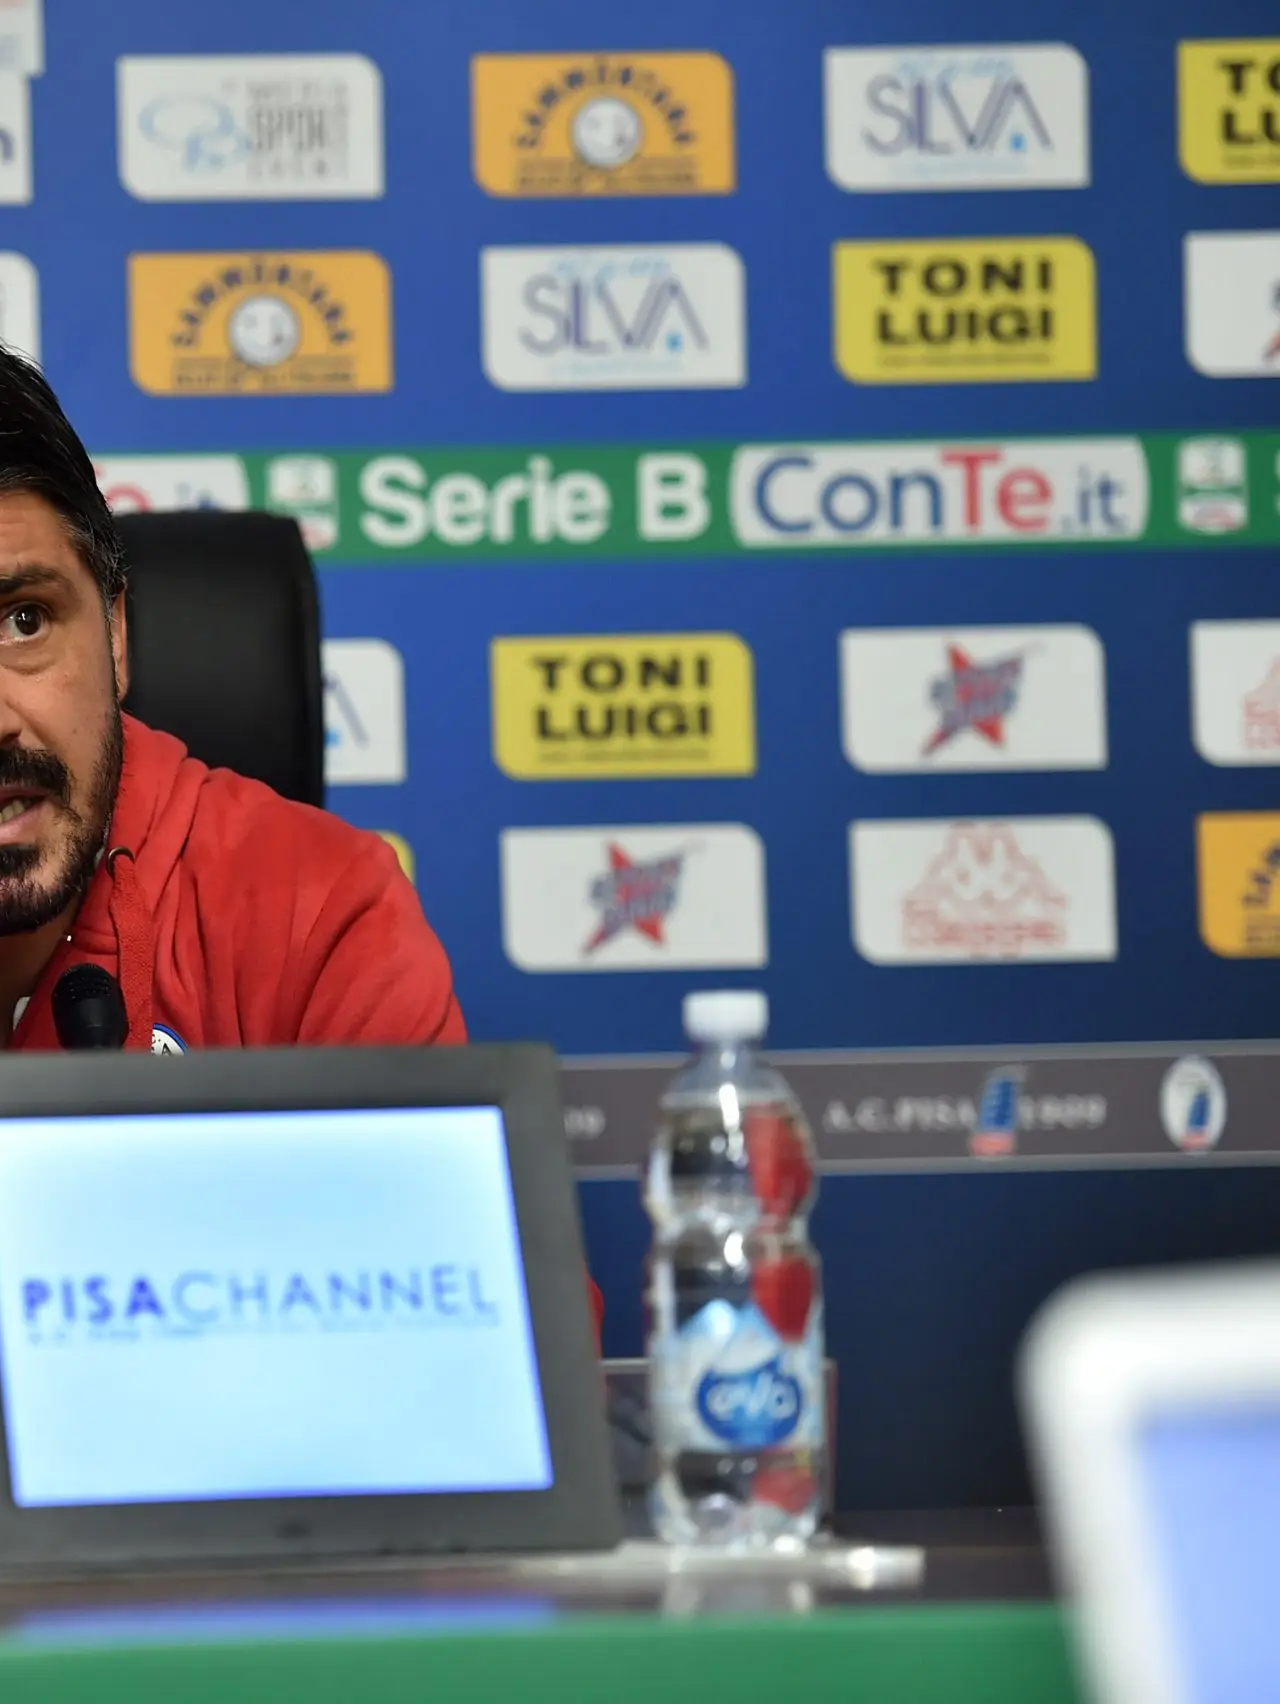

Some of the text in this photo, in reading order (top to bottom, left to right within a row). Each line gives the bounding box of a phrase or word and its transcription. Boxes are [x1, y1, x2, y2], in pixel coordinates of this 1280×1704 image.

[872, 256, 1056, 298] TONI
[875, 305, 1056, 347] LUIGI
[358, 452, 712, 548] Serie B
[752, 445, 1128, 536] ConTe.it
[529, 652, 711, 693] TONI
[534, 701, 712, 743] LUIGI
